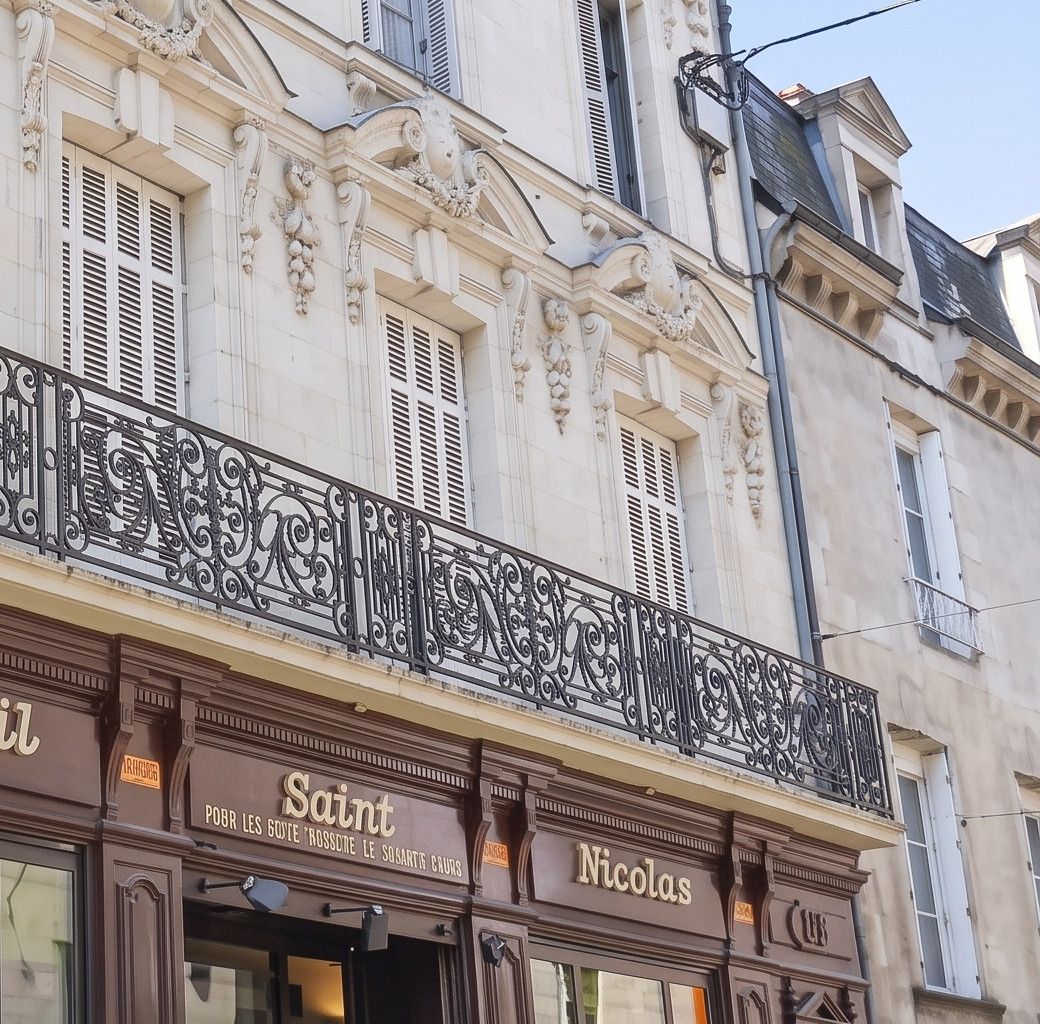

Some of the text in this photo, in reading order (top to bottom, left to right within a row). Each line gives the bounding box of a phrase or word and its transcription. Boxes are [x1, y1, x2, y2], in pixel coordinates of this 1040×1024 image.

[242, 812, 263, 836] LES
[363, 839, 376, 860] LE
[281, 771, 397, 838] Saint
[576, 842, 693, 905] Nicolas
